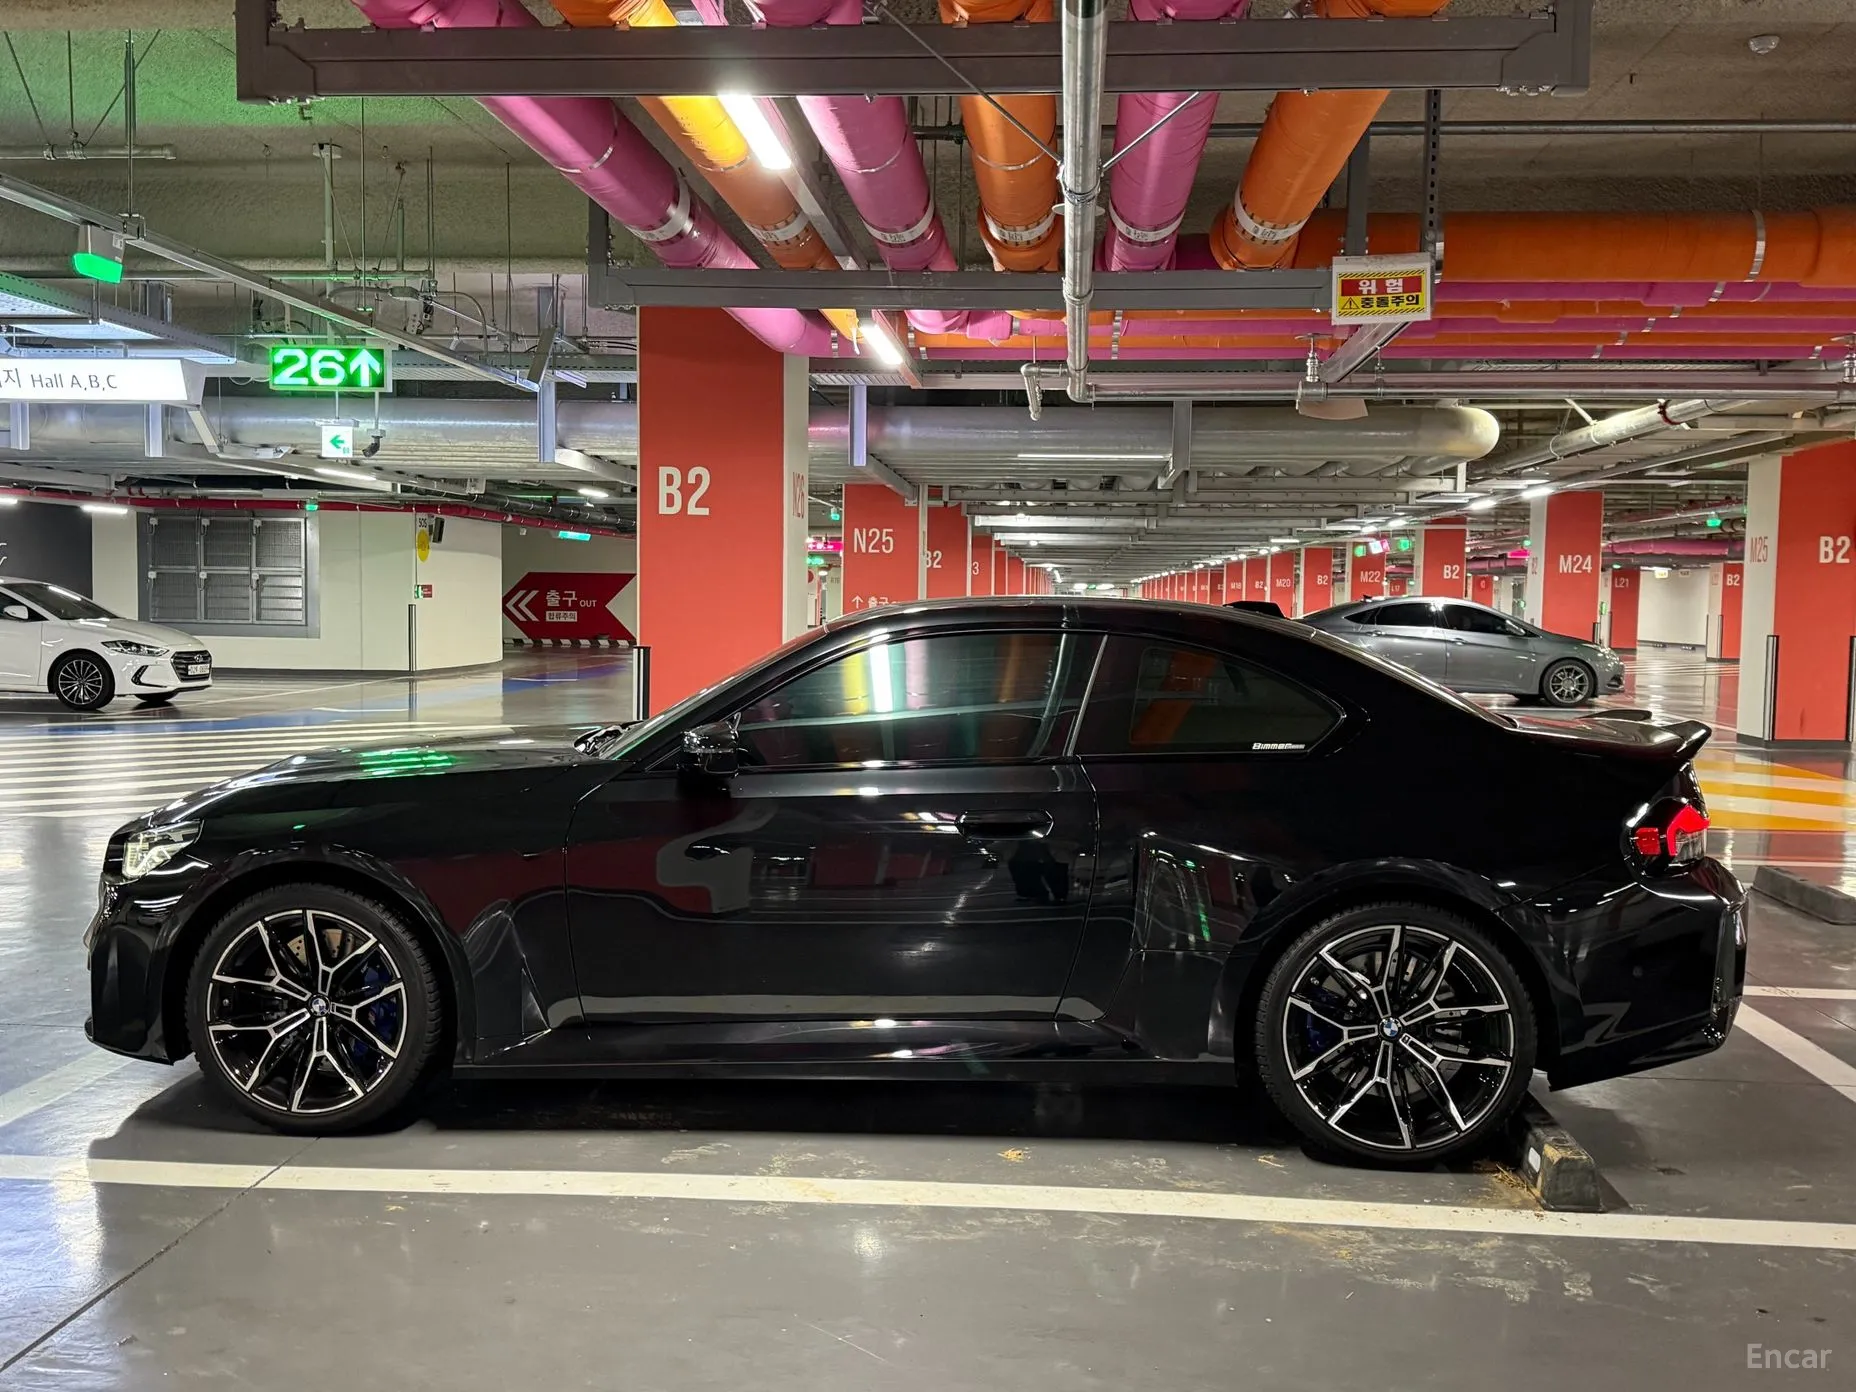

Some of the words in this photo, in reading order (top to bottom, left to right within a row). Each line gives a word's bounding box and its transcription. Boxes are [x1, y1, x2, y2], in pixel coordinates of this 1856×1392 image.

[1361, 295, 1420, 309] 충돌주의
[31, 374, 64, 389] Hall
[70, 375, 118, 391] A,B,C
[658, 466, 711, 516] B2
[853, 528, 894, 553] N25
[1750, 536, 1768, 563] M25
[1819, 535, 1851, 564] B2
[1443, 564, 1460, 579] B2
[1559, 554, 1593, 574] M24
[1275, 578, 1291, 588] M20
[1316, 575, 1328, 585] B2
[1360, 570, 1381, 583] M22
[1726, 574, 1741, 586] B2
[545, 589, 578, 607] 출구
[579, 599, 597, 608] OUT
